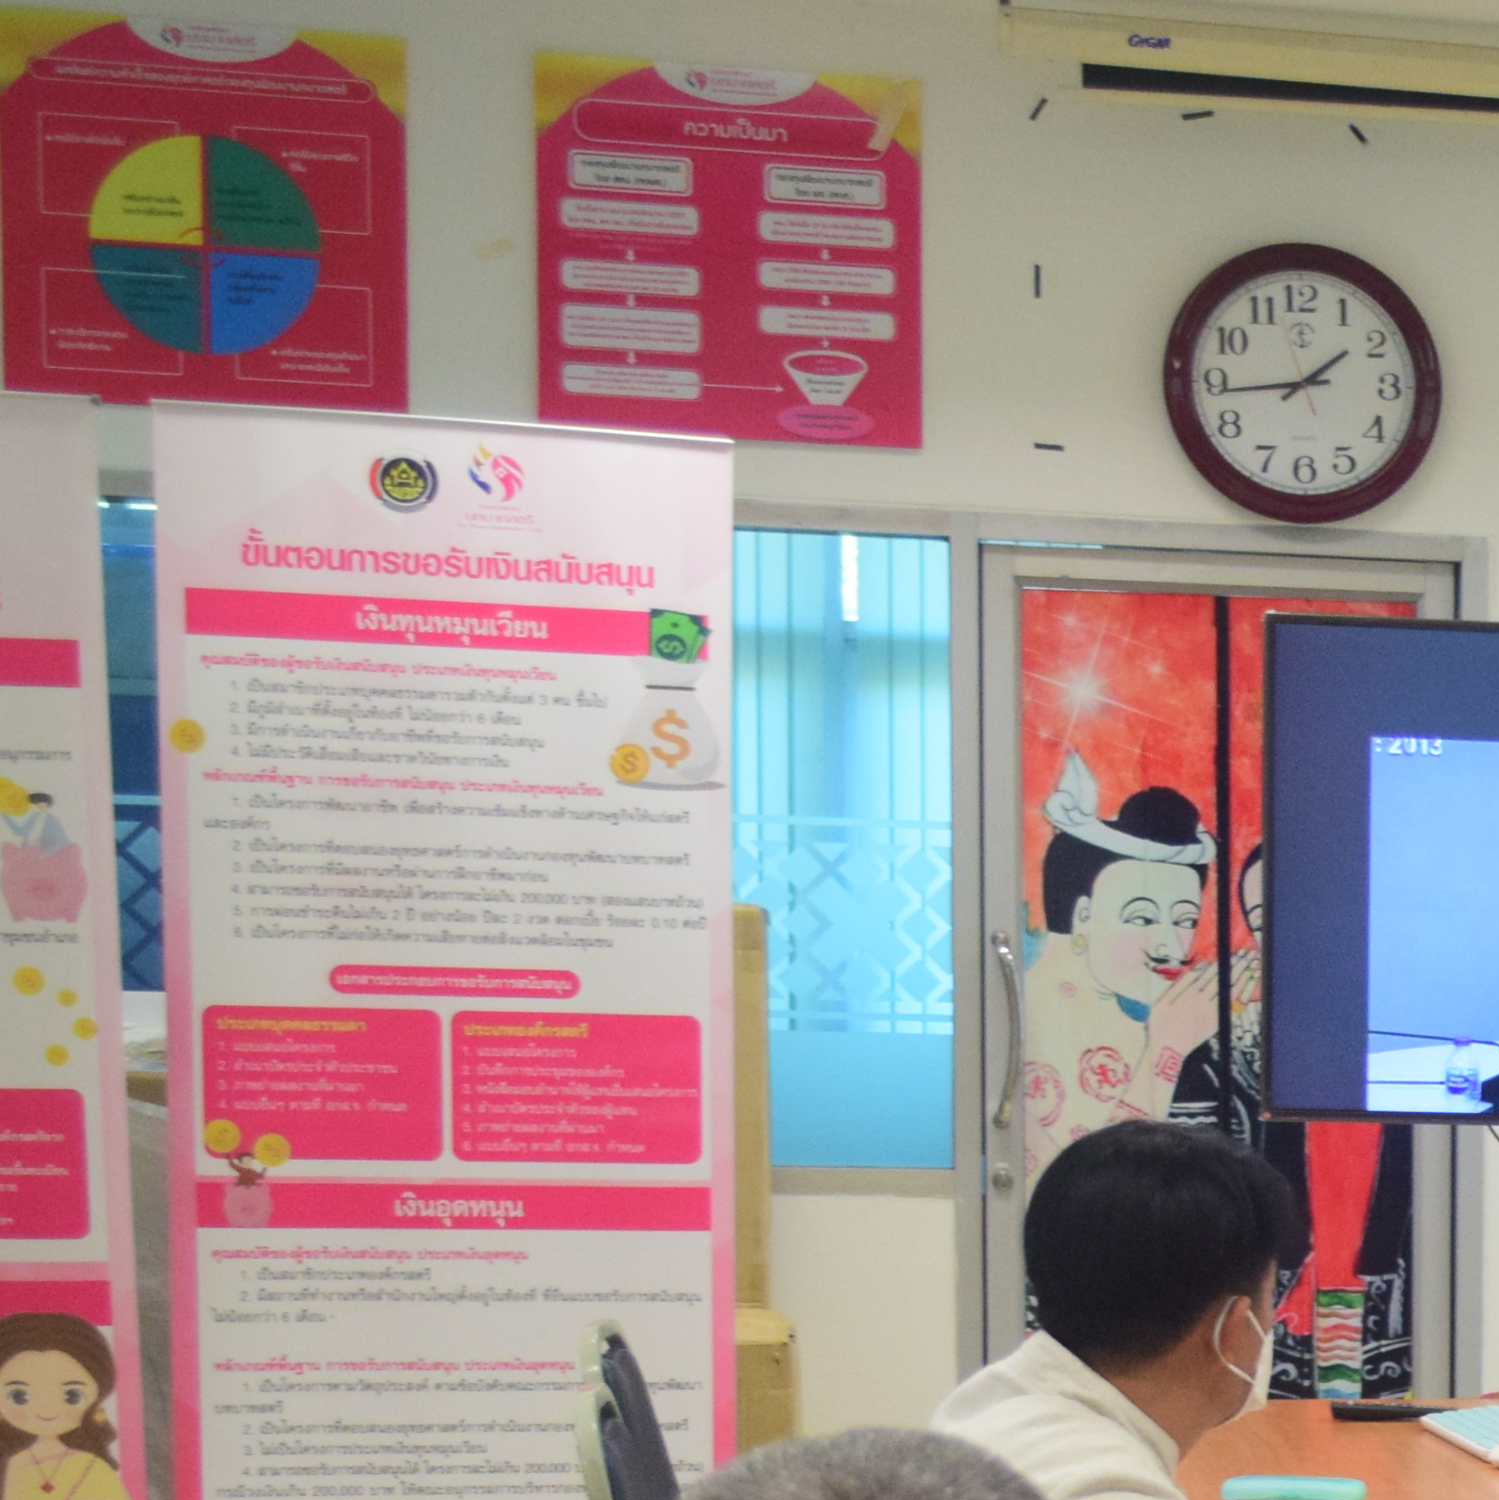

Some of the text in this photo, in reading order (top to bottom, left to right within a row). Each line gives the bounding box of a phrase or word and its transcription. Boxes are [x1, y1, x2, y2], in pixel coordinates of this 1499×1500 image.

[684, 118, 788, 142] ความเป็นมา
[1250, 296, 1275, 325] 11
[1283, 284, 1317, 313] 12
[1338, 298, 1350, 326] 1
[1216, 327, 1248, 355] 10
[1367, 331, 1386, 358] 2
[1204, 368, 1228, 396] 9
[1378, 373, 1402, 401] 3
[1218, 410, 1242, 438] 8
[1363, 416, 1384, 443] 4
[1255, 445, 1278, 473] 7
[1293, 455, 1317, 483] 6
[1332, 447, 1356, 474] 5
[356, 605, 548, 645] เงินทุนหมุนเวียน
[490, 710, 521, 725] เดือน
[570, 895, 596, 905] บาท
[512, 912, 522, 924] 2
[394, 1193, 524, 1230] เงินอุดหนุน
[368, 1486, 395, 1495] บาท
